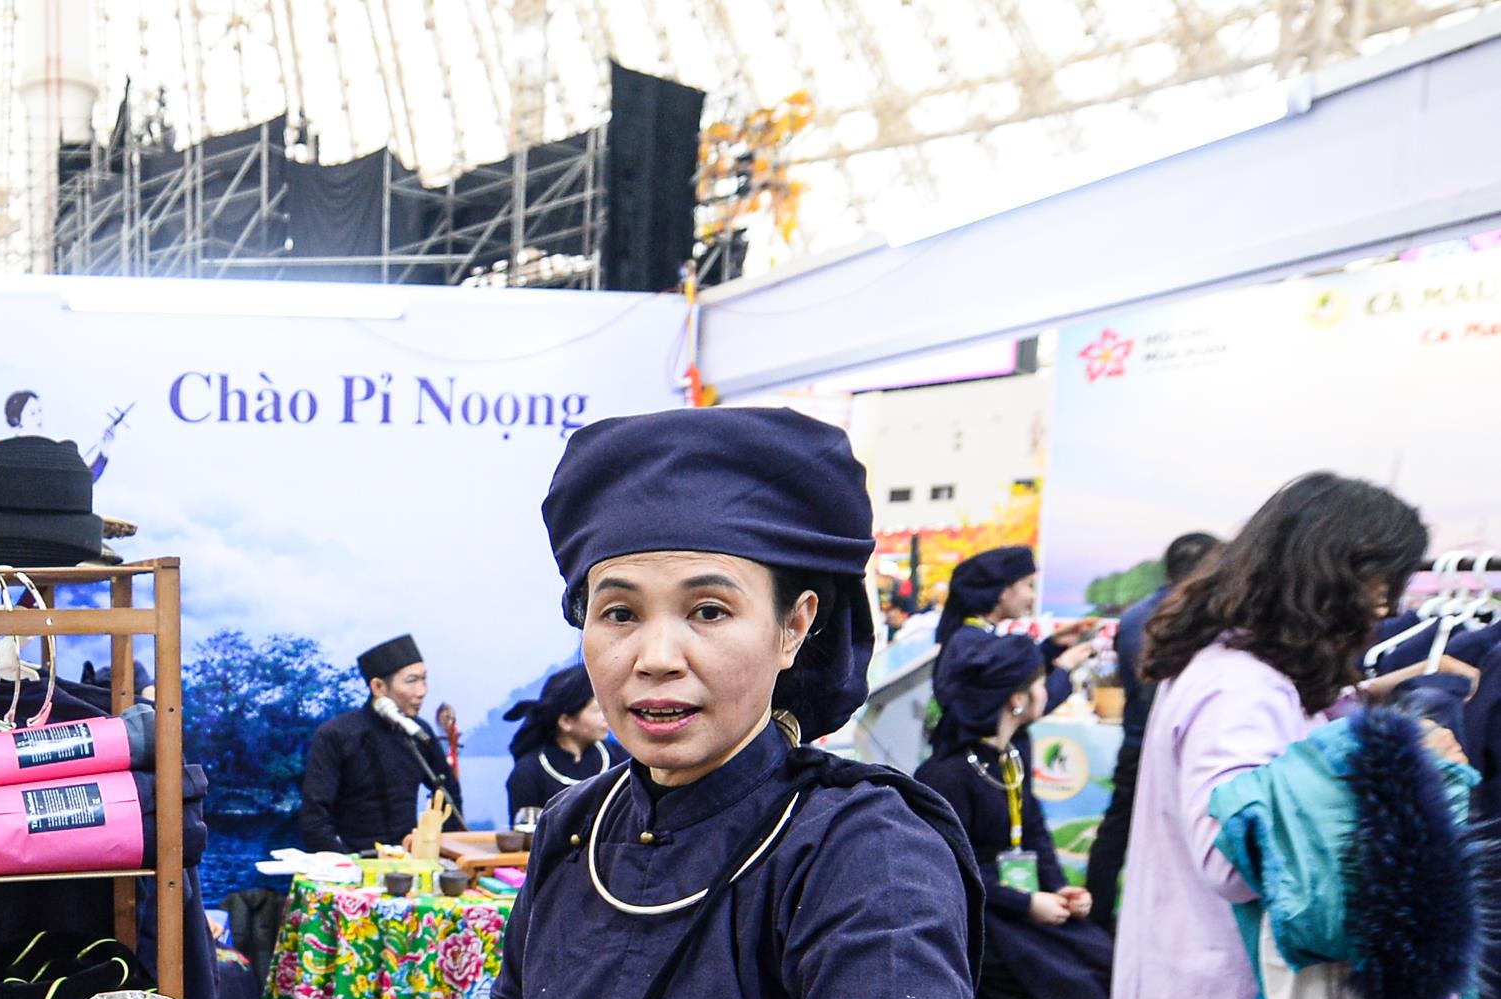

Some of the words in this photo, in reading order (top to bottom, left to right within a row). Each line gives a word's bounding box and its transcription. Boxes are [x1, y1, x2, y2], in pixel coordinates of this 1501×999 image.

[168, 371, 319, 424] Chào
[339, 372, 394, 424] Pỉ
[415, 376, 591, 441] Noọng
